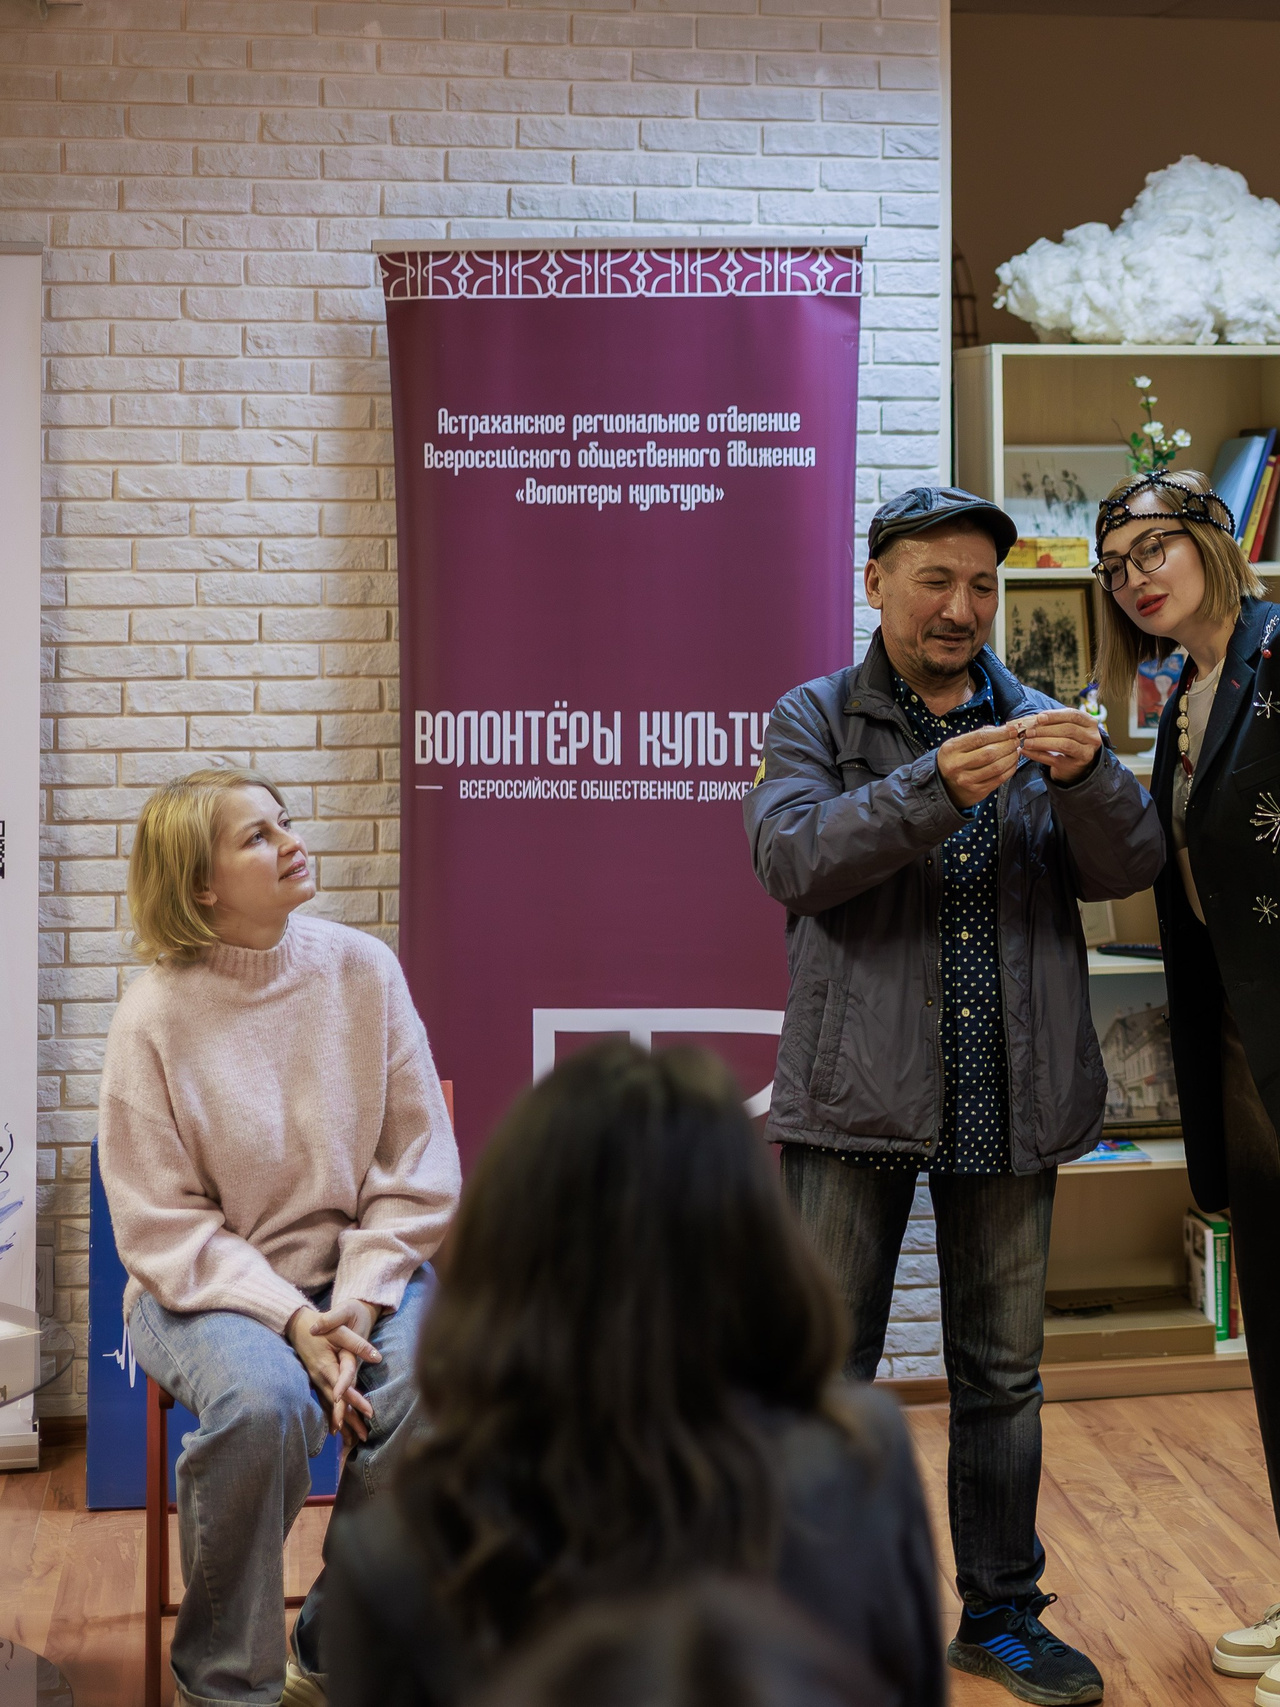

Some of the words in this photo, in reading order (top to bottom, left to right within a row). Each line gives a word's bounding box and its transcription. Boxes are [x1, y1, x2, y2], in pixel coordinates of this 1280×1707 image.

[438, 407, 565, 441] Астраханское
[573, 413, 699, 441] региональное
[706, 406, 800, 433] отделение
[424, 443, 571, 476] Всероссийского
[577, 441, 720, 472] общественного
[727, 440, 815, 471] движения
[516, 477, 621, 511] «Волонтеры
[629, 483, 724, 511] культуры»
[415, 700, 621, 767] ВОЛОНТЁРЫ
[639, 711, 769, 769] КУЛЬТУ
[459, 776, 577, 800] ВСЕРОССИЙСКОЕ
[581, 780, 694, 802] ОБЩЕСТВЕННОЕ
[697, 780, 753, 802] ДВИЖЕ
